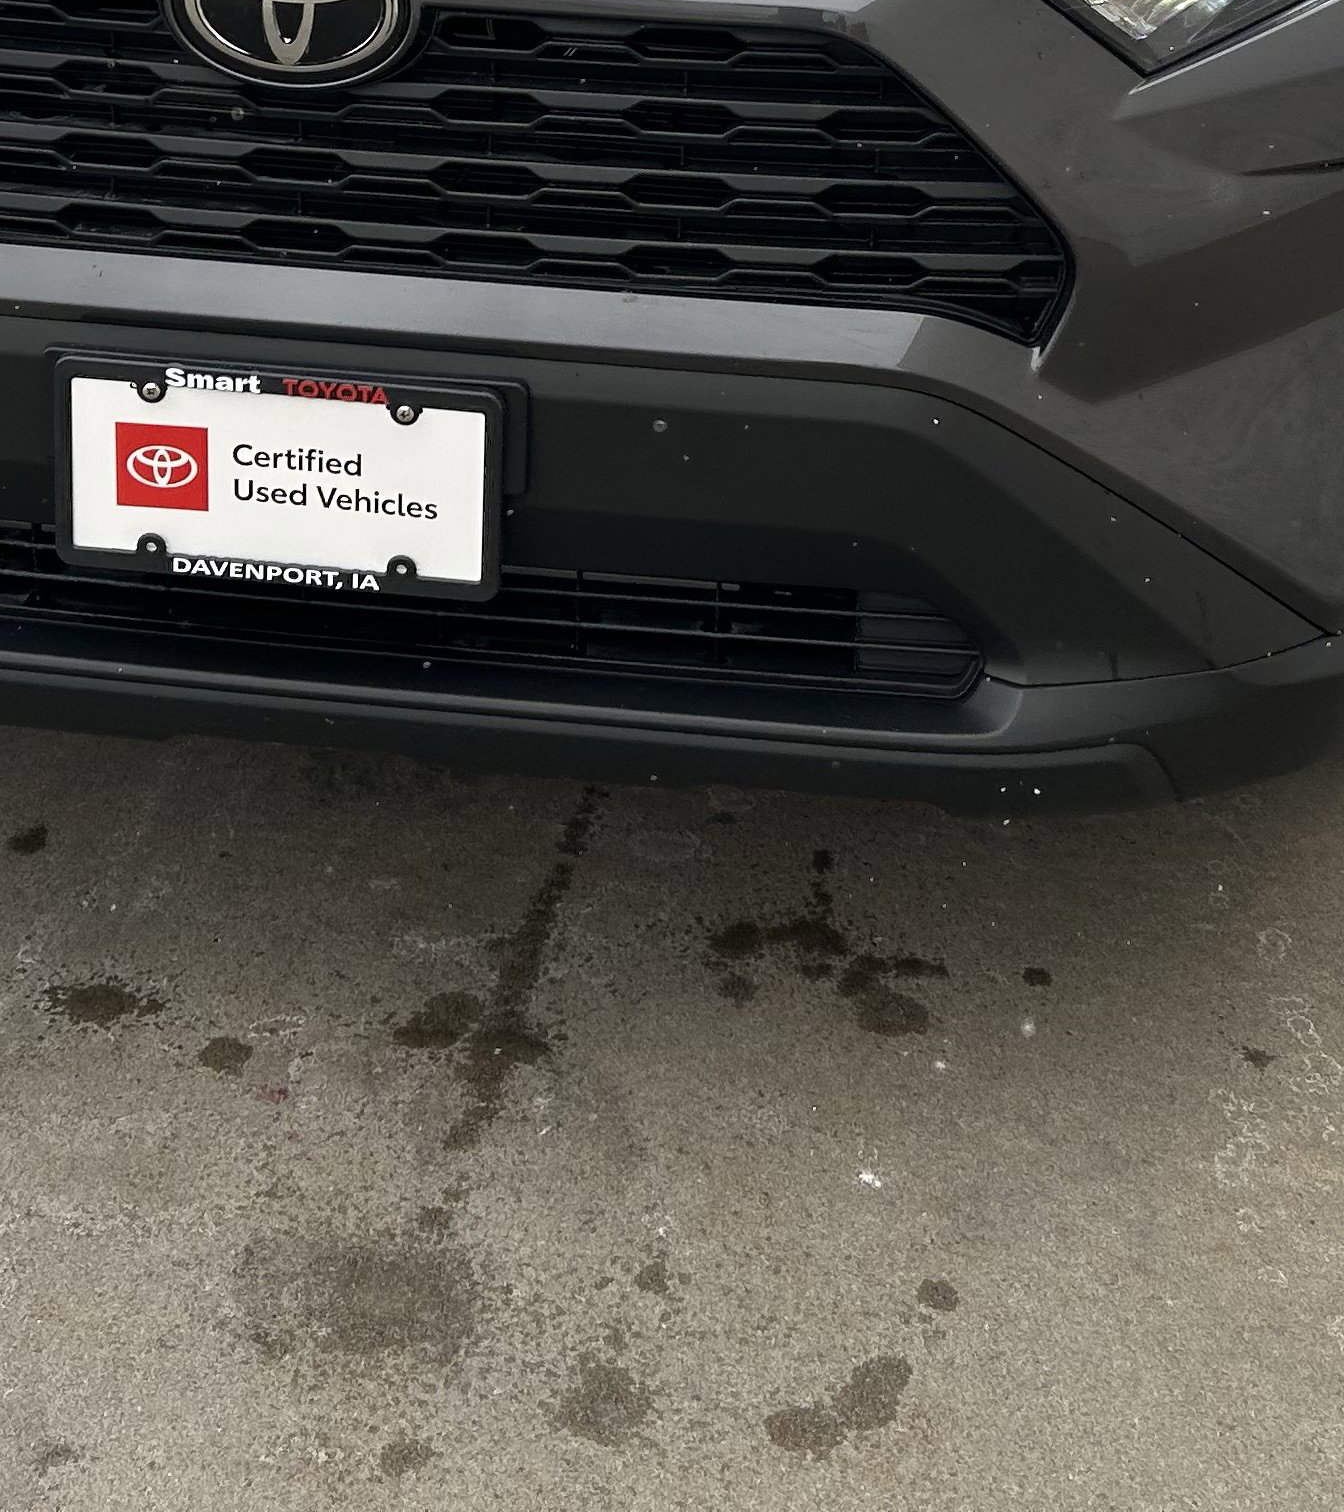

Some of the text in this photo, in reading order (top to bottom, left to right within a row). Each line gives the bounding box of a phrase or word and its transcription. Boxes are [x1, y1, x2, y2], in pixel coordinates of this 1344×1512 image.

[164, 367, 390, 405] Smart TOYOTA
[232, 443, 363, 477] Certified
[234, 478, 438, 520] Used Vehicles
[172, 557, 380, 591] DAVENPORT, IA
